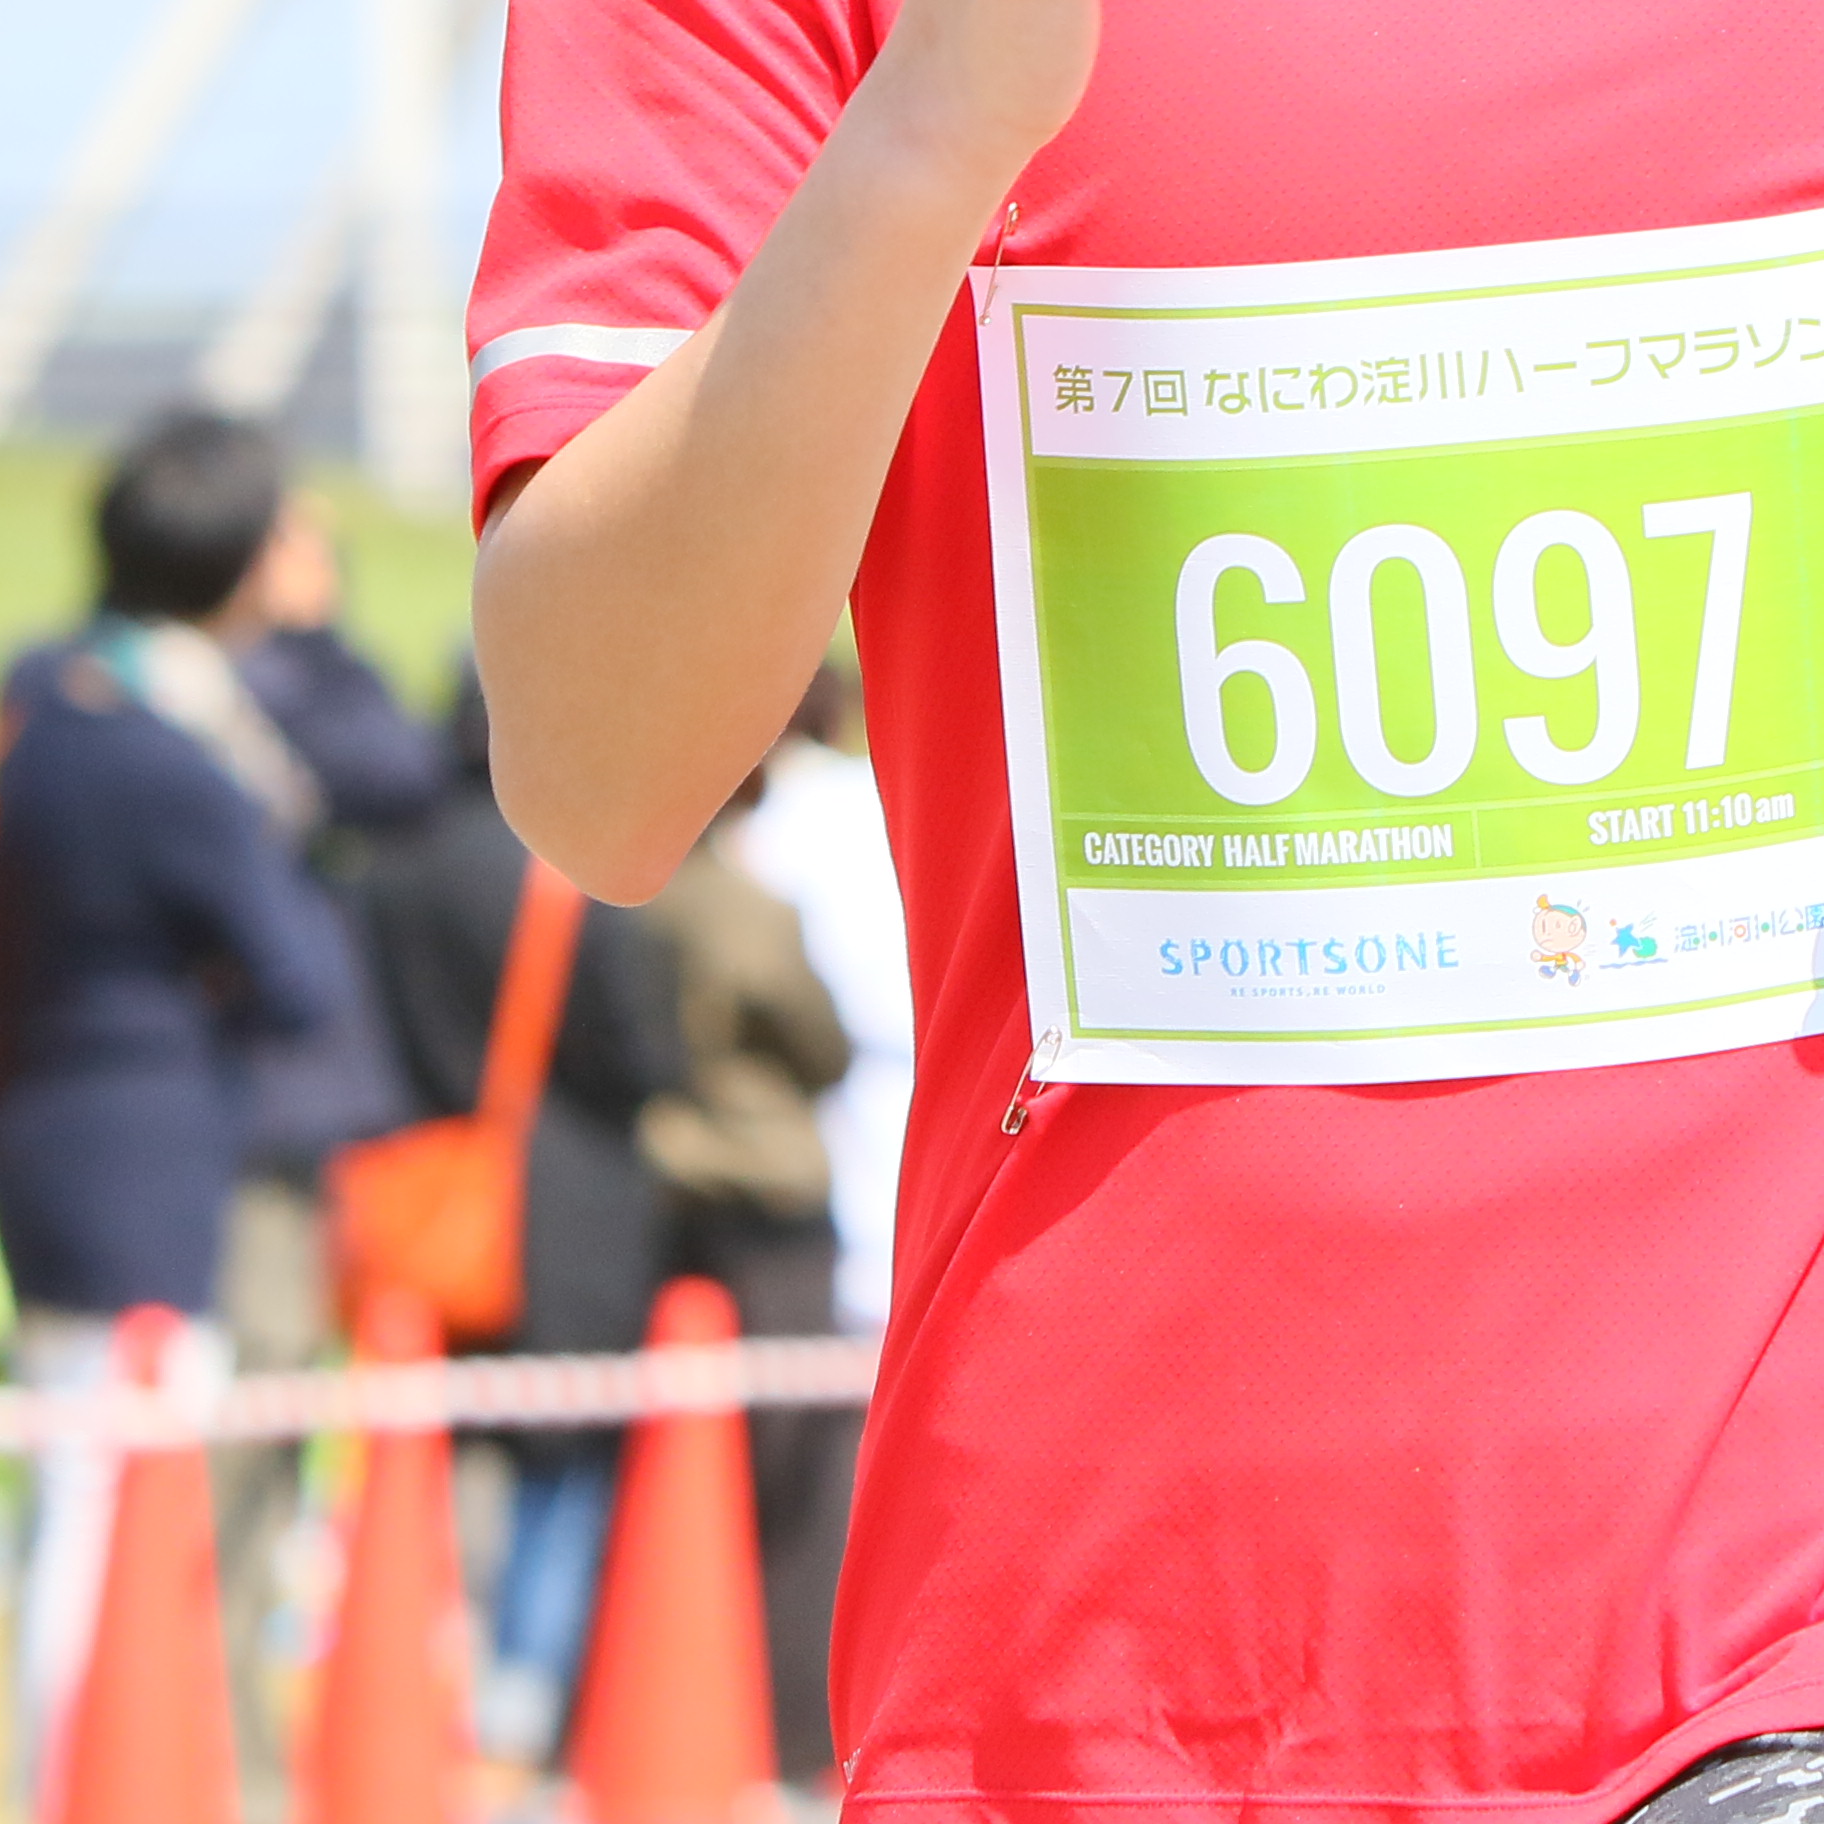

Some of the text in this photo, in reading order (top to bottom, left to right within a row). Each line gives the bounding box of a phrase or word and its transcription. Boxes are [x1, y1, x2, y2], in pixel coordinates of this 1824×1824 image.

[1052, 364, 1188, 416] 第7回
[1174, 490, 1753, 806] 6097
[1083, 824, 1453, 867] CATEGORY HALF MARATHON
[1588, 804, 1675, 846] START
[1159, 931, 1460, 976] SPORTSONE
